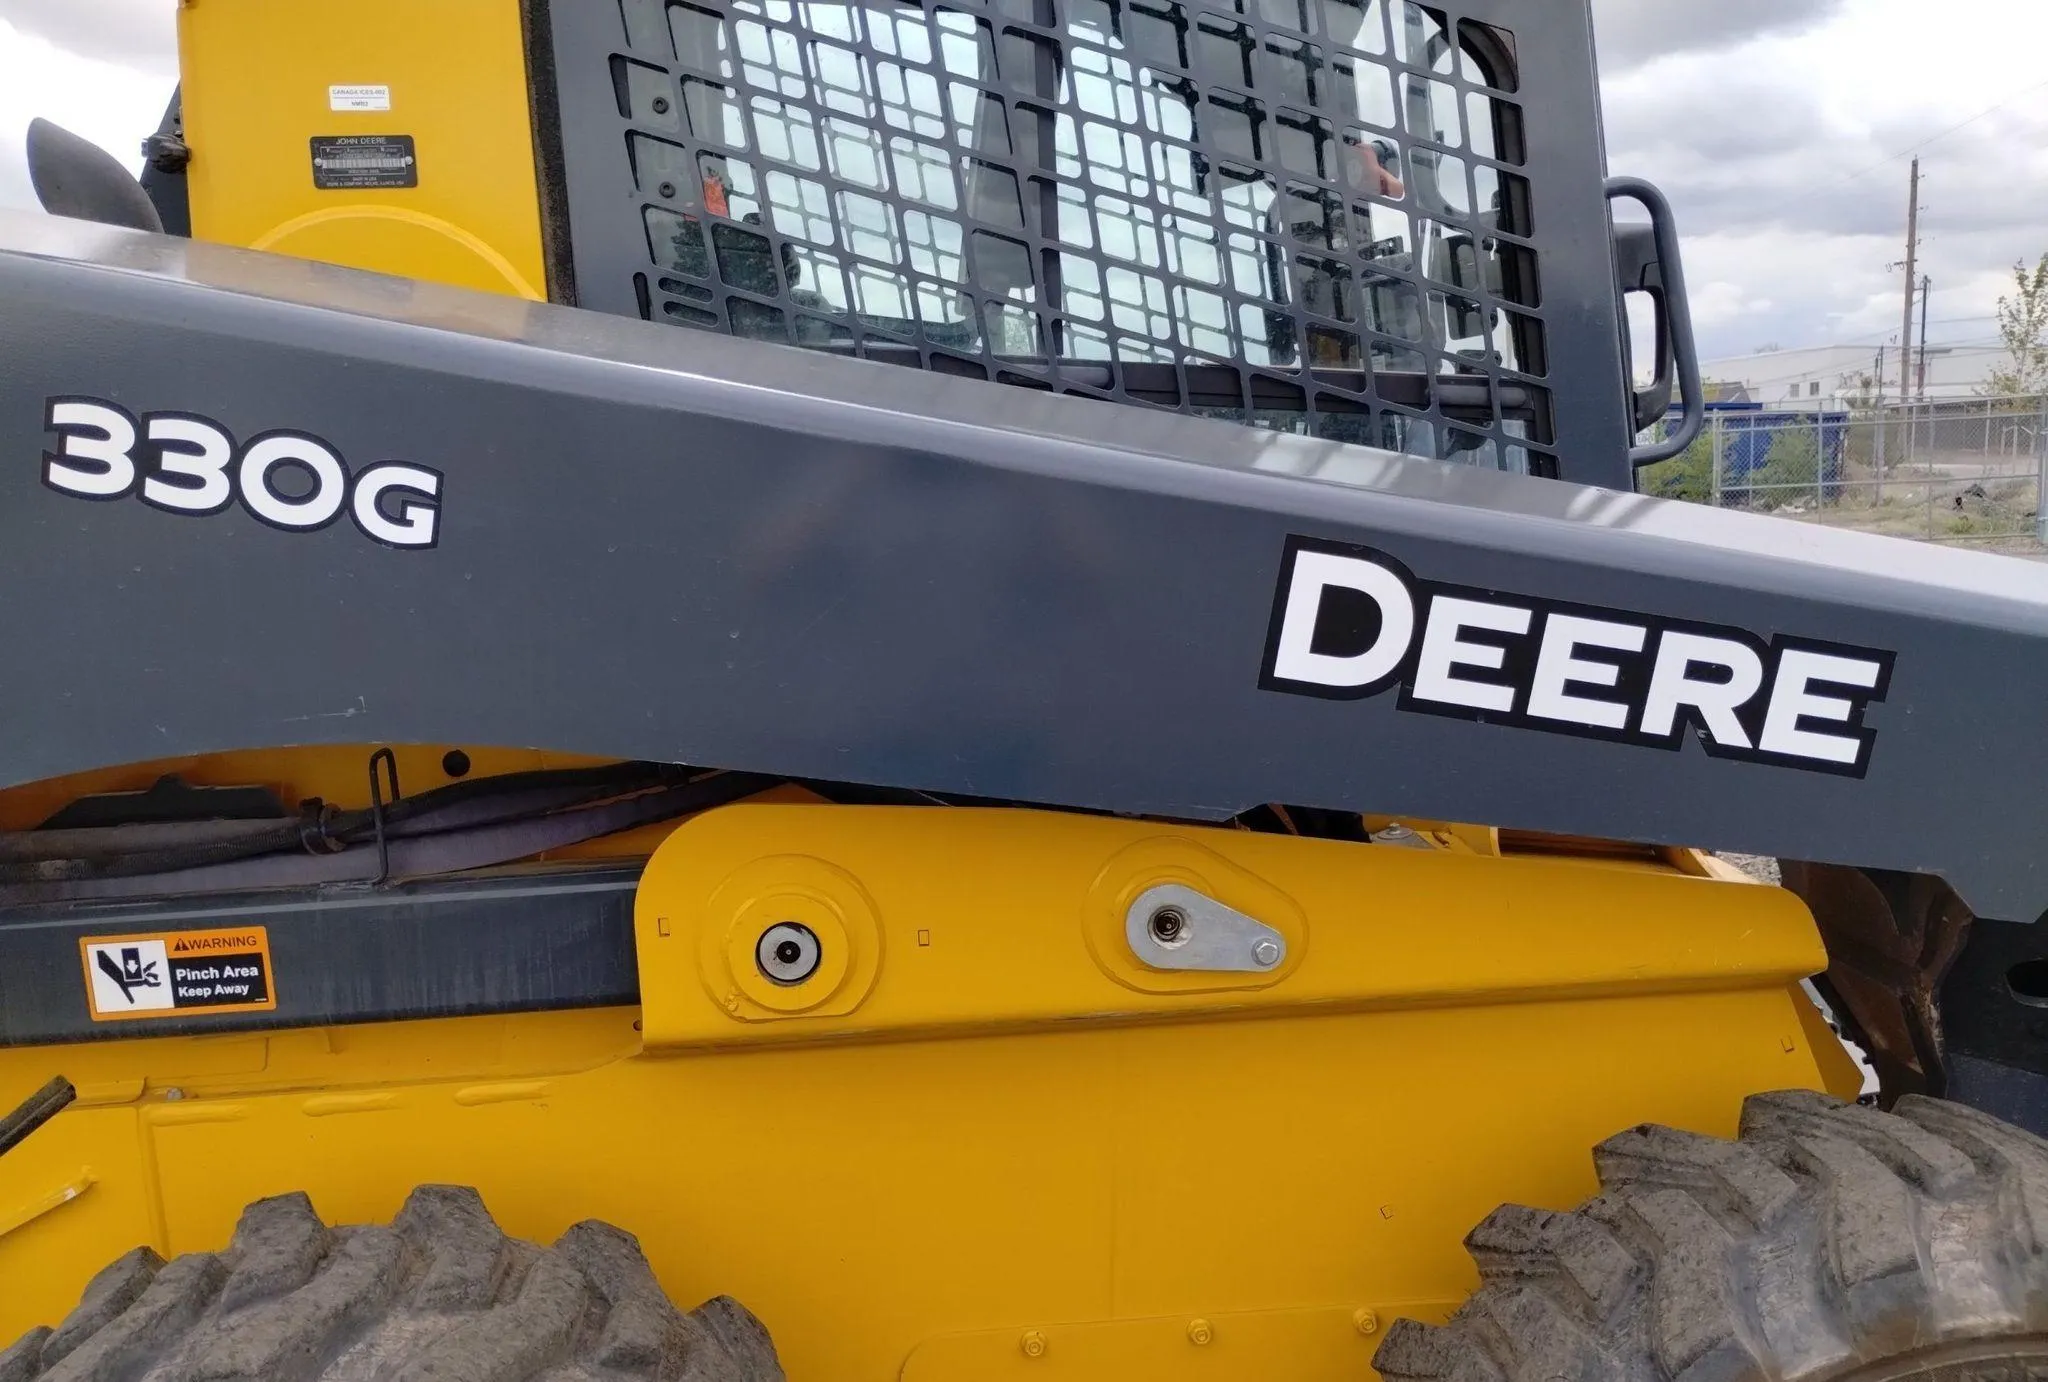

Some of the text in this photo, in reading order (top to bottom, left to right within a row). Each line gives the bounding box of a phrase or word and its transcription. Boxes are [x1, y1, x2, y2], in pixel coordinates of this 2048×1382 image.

[45, 400, 440, 546] 330G
[1270, 547, 1884, 766] DEERE
[188, 936, 257, 950] WARNING
[175, 965, 259, 981] Pinch Area
[178, 984, 249, 998] Keep Away
